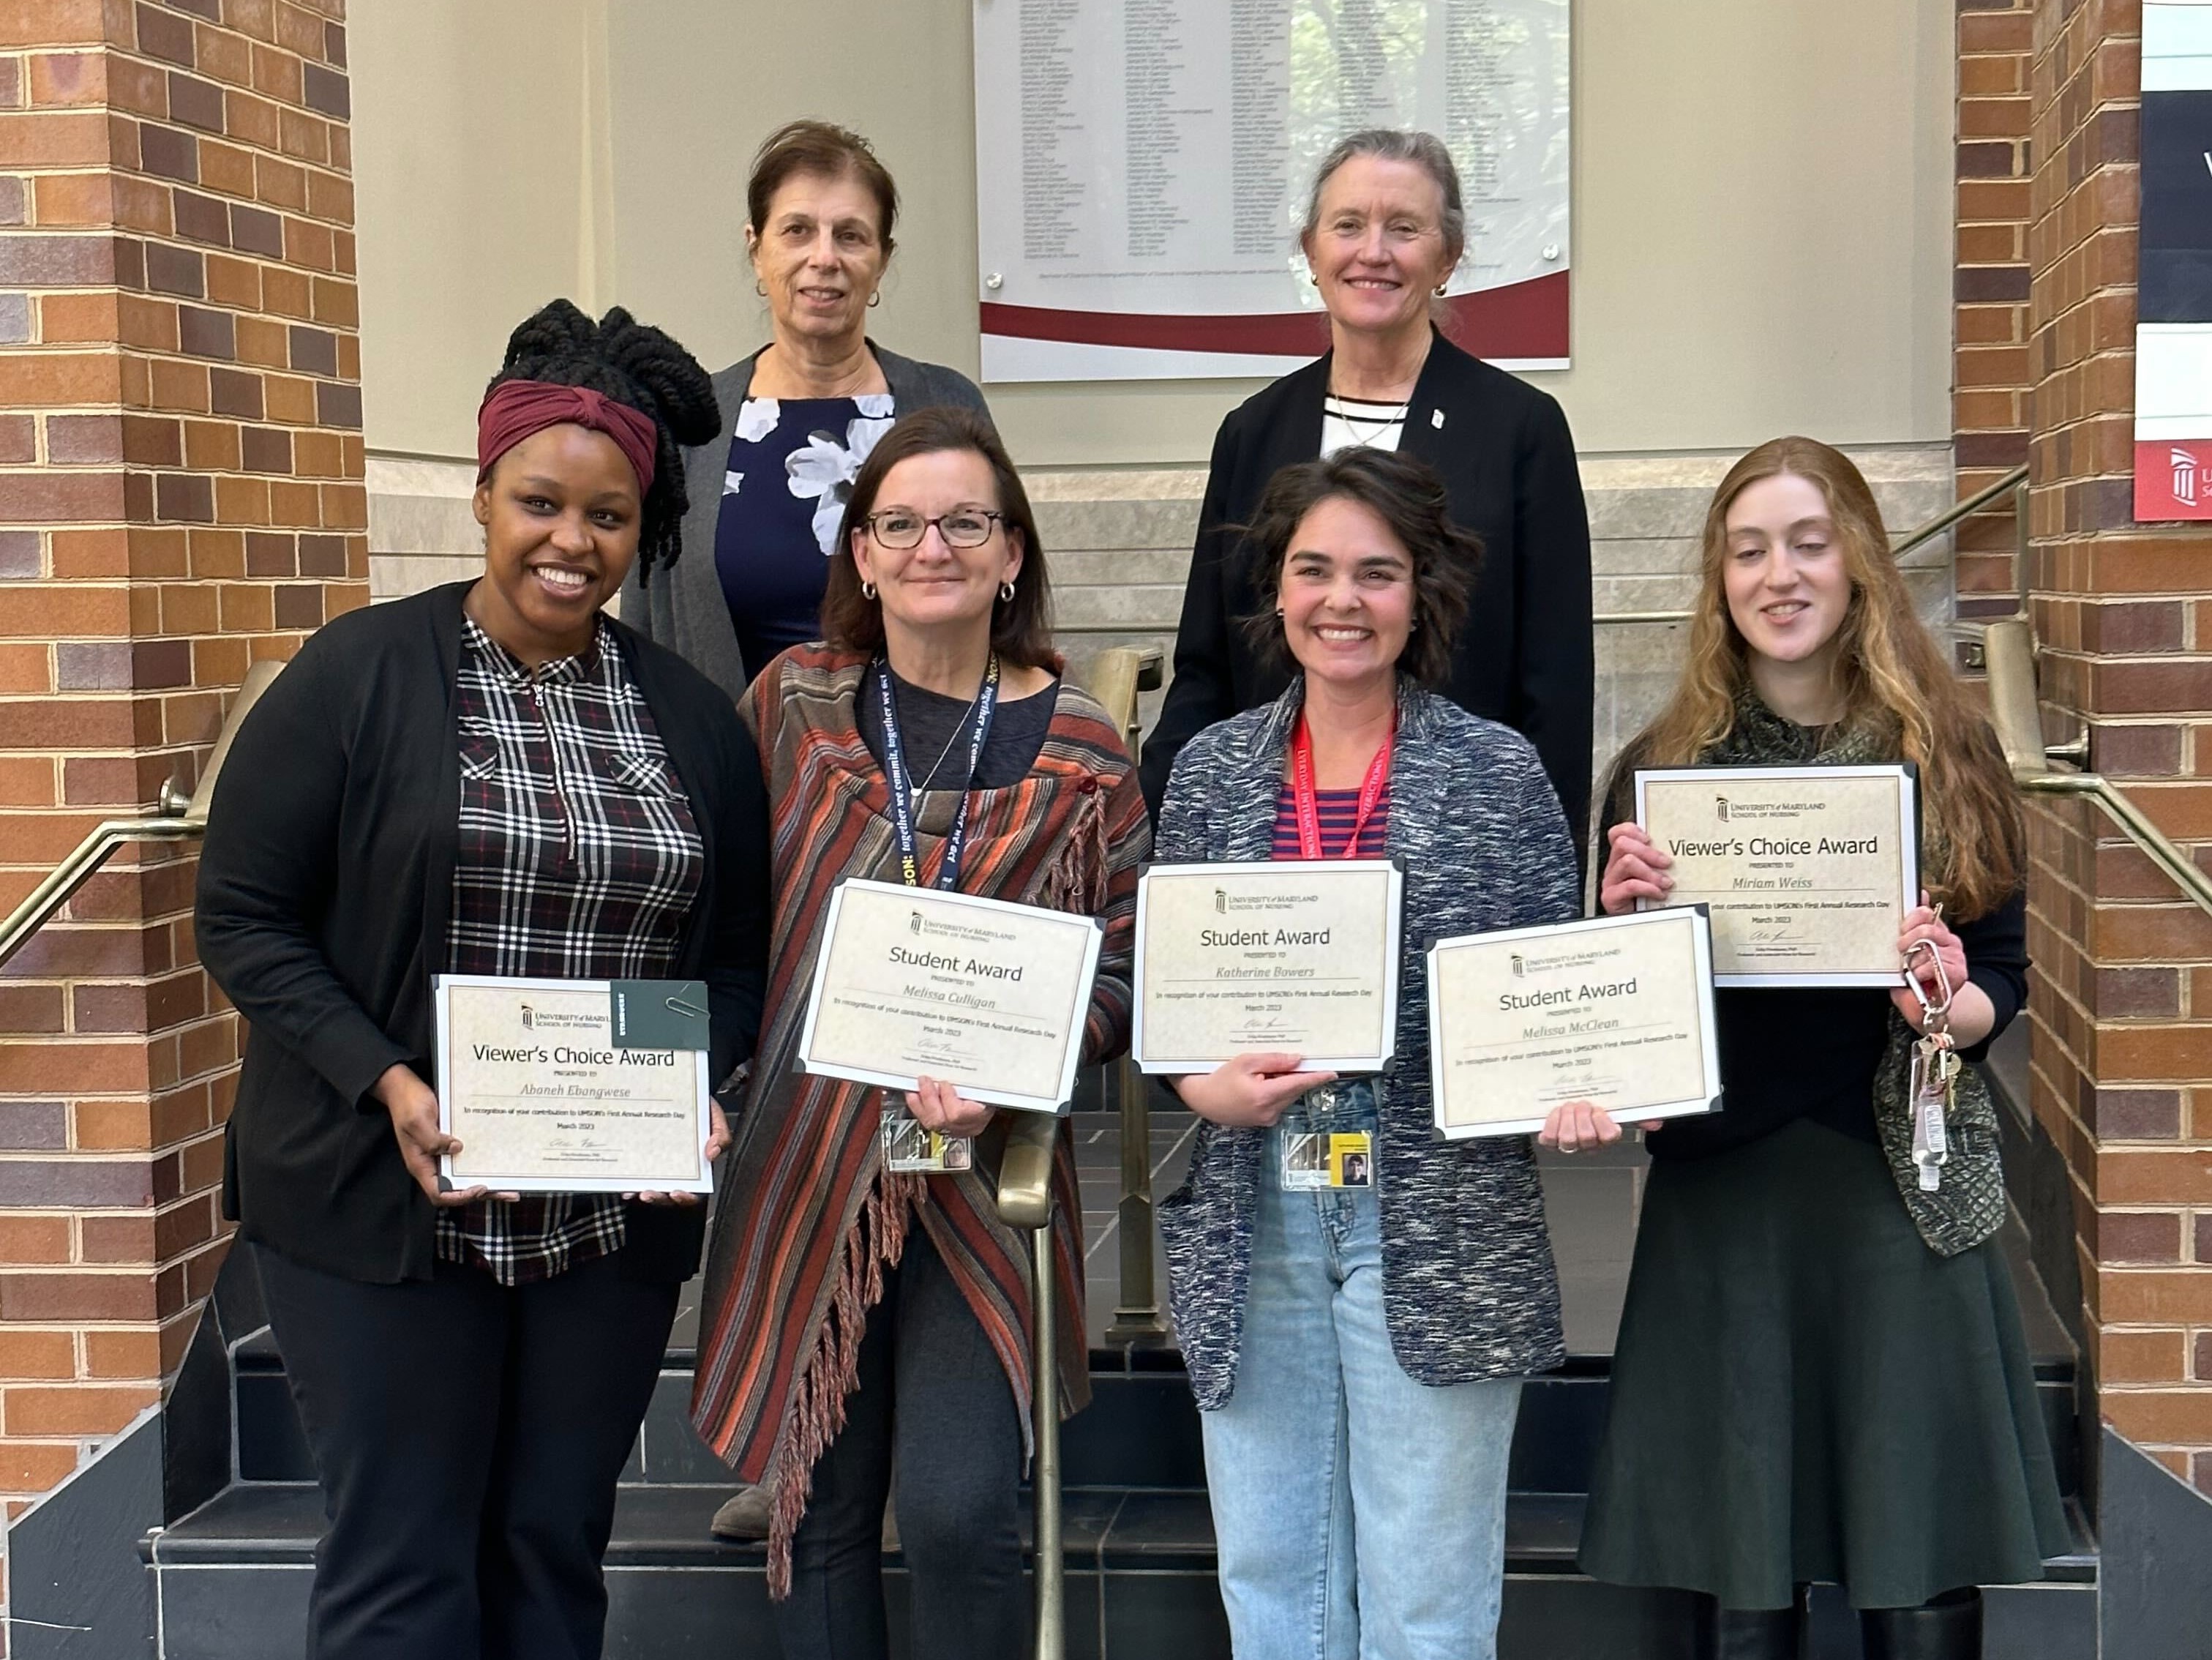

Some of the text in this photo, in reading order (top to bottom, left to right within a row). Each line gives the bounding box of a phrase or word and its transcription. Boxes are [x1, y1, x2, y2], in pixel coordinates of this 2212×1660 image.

[882, 691, 890, 705] we
[977, 686, 993, 726] together
[882, 706, 898, 748] together
[973, 728, 983, 741] we
[896, 792, 904, 806] we
[896, 808, 912, 851] together
[1668, 836, 1878, 856] Viewer's Choice Award
[1732, 877, 1812, 889] Miriam Weiss
[1201, 927, 1330, 946] Student Award
[889, 946, 1022, 982] Student Award
[1216, 966, 1315, 978] Katherine Bowers
[903, 985, 995, 1009] Melissa Culligan
[1500, 977, 1637, 1011] Student Award
[585, 1014, 611, 1022] MARYL
[1523, 1019, 1619, 1039] Melissa McClean
[473, 1044, 674, 1066] Viewer's Choice Award
[520, 1083, 631, 1099] Abaneh Ebangwese
